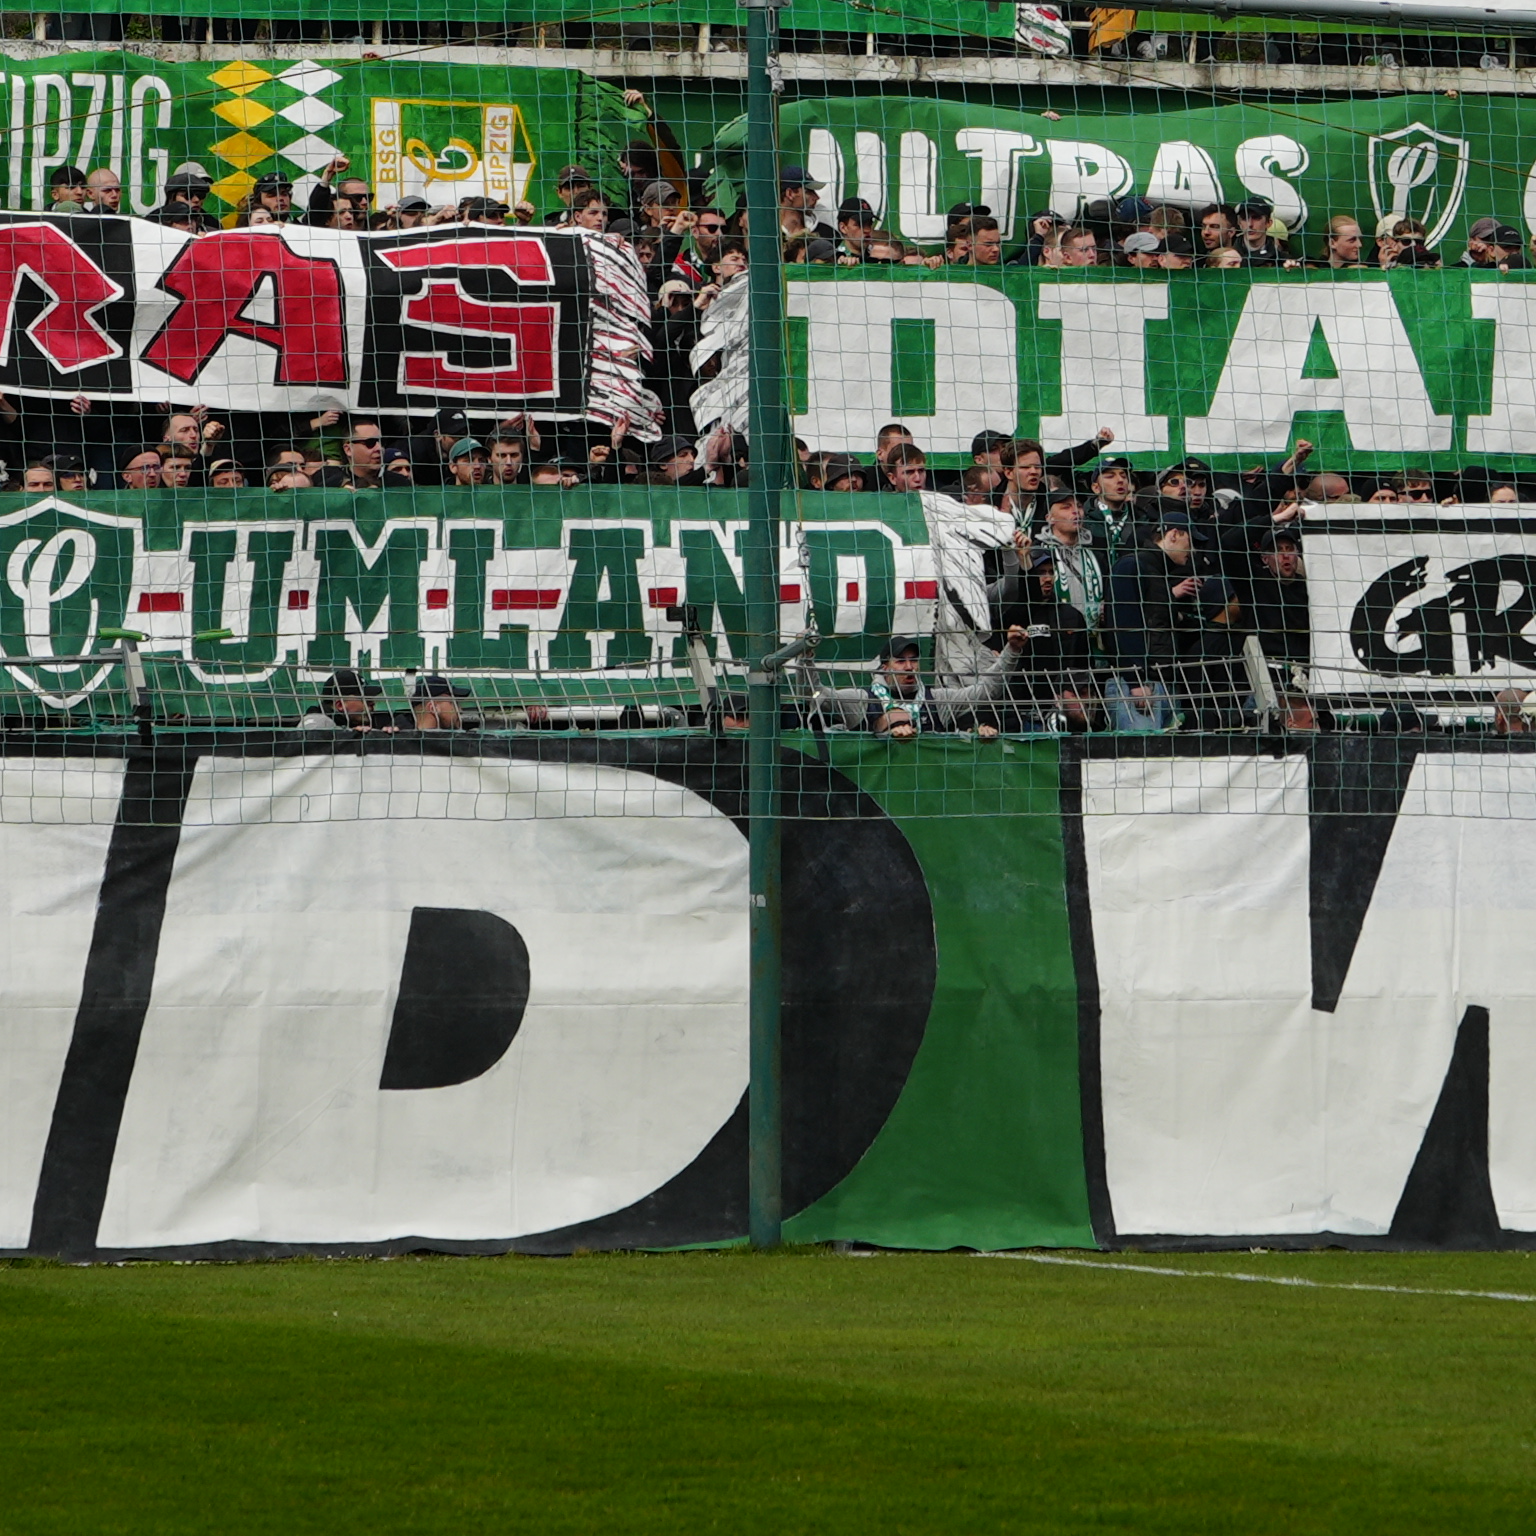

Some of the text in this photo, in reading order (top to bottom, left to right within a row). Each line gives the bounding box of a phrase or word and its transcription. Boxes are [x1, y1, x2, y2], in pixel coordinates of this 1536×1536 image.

[379, 129, 397, 183] BSG
[490, 114, 509, 205] LEIPZIG
[807, 127, 1309, 244] ULTRAS
[183, 519, 907, 682] UMLAND
